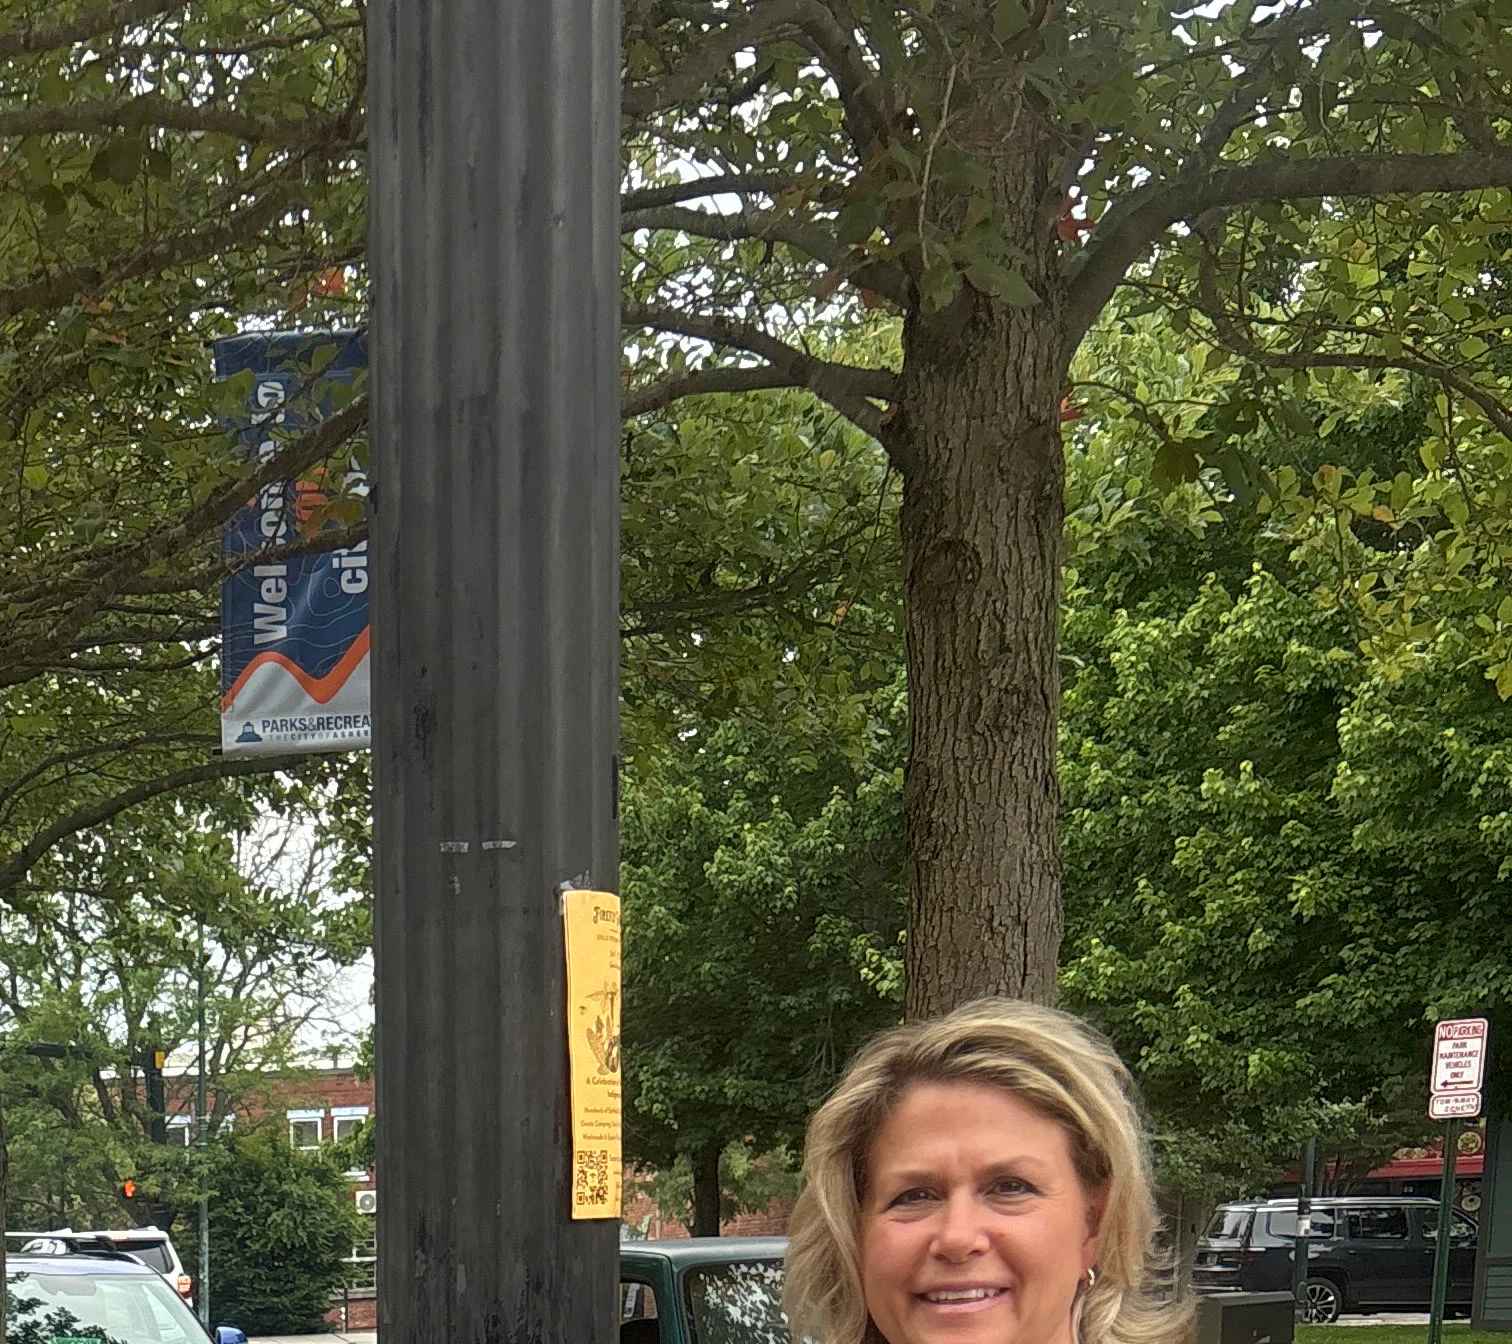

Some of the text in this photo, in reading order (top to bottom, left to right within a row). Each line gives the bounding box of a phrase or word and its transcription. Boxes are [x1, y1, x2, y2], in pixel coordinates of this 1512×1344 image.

[1439, 1025, 1482, 1039] NO PARKING
[1452, 1041, 1468, 1050] PARK
[1439, 1050, 1479, 1060] MAINTENANCE
[1445, 1060, 1472, 1070] VEHICLES
[1450, 1071, 1465, 1079] ONLY
[1436, 1097, 1475, 1105] TOW-AWAY
[1444, 1105, 1465, 1113] ZONE
